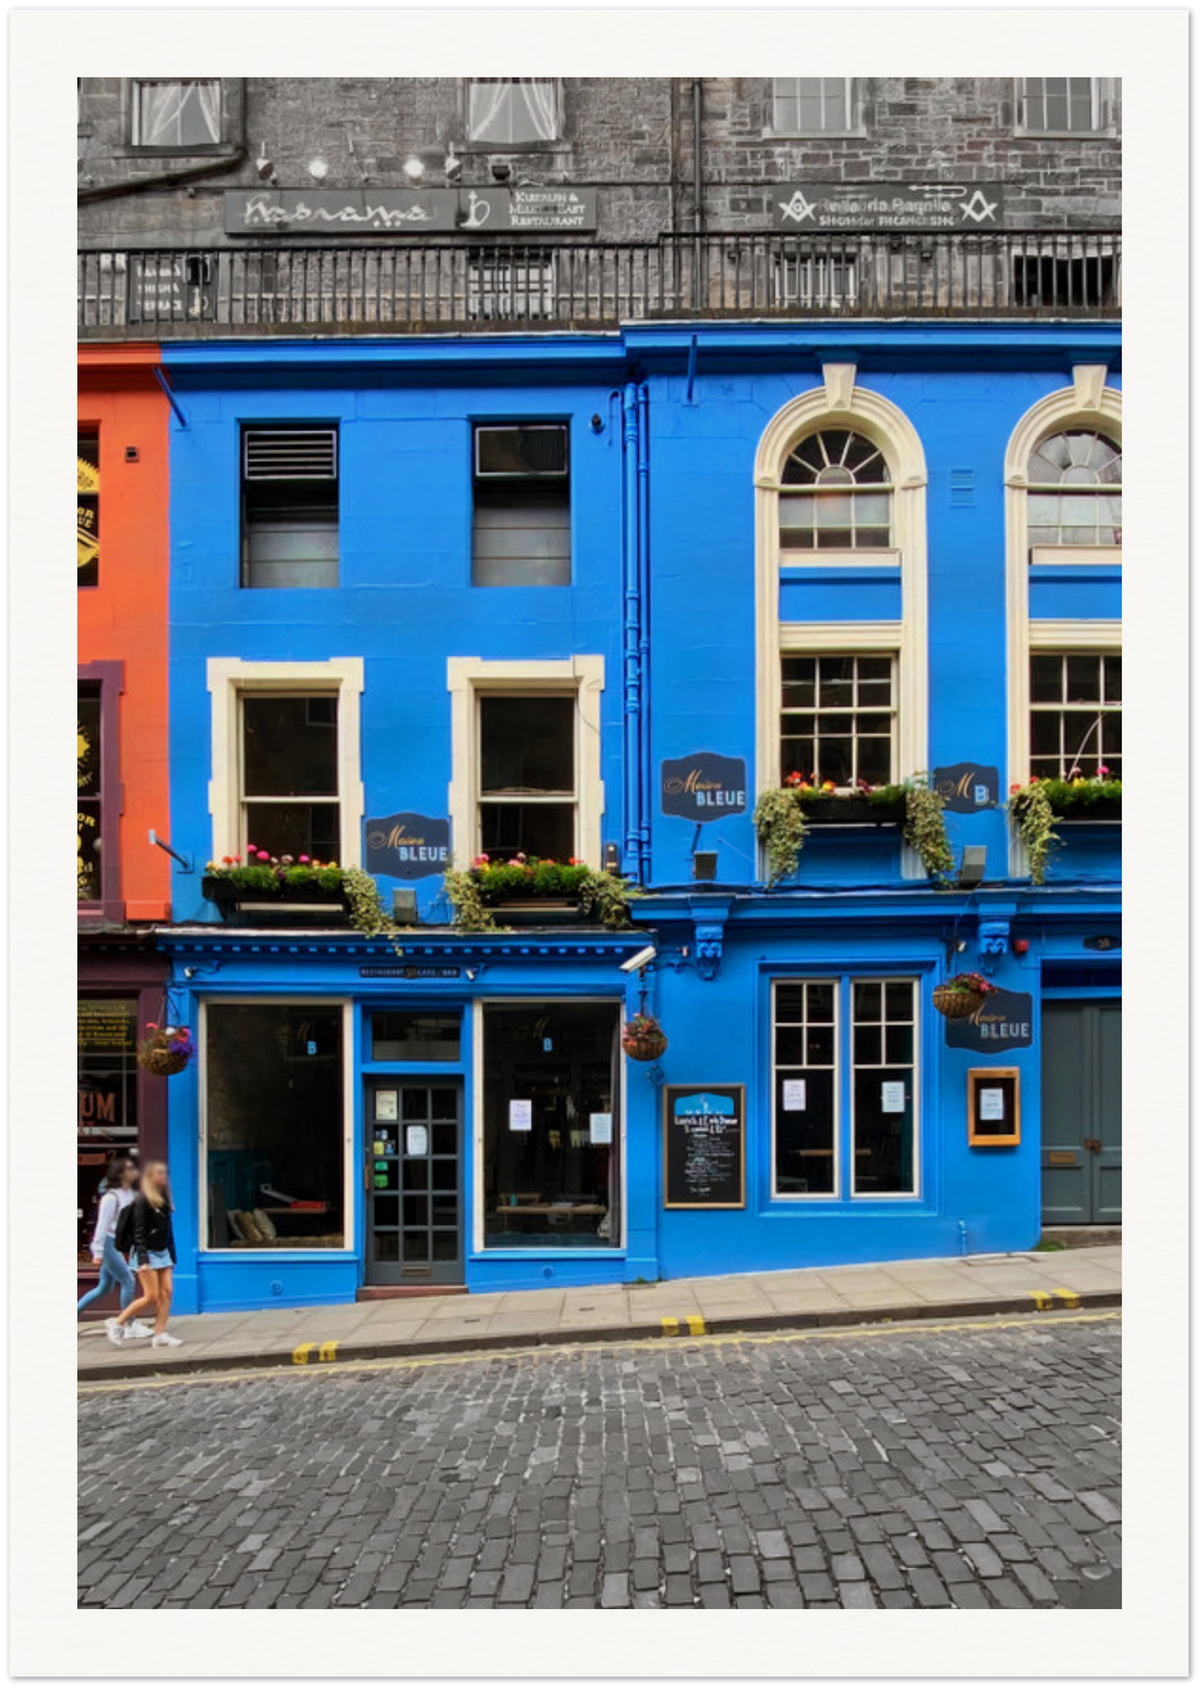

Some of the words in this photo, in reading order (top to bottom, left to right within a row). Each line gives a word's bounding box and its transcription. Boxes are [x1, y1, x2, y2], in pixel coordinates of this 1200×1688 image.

[696, 789, 746, 807] BLEUE
[974, 784, 990, 806] B
[399, 846, 447, 861] BLEUE
[980, 1022, 1030, 1038] BLEUE
[307, 1041, 317, 1055] B
